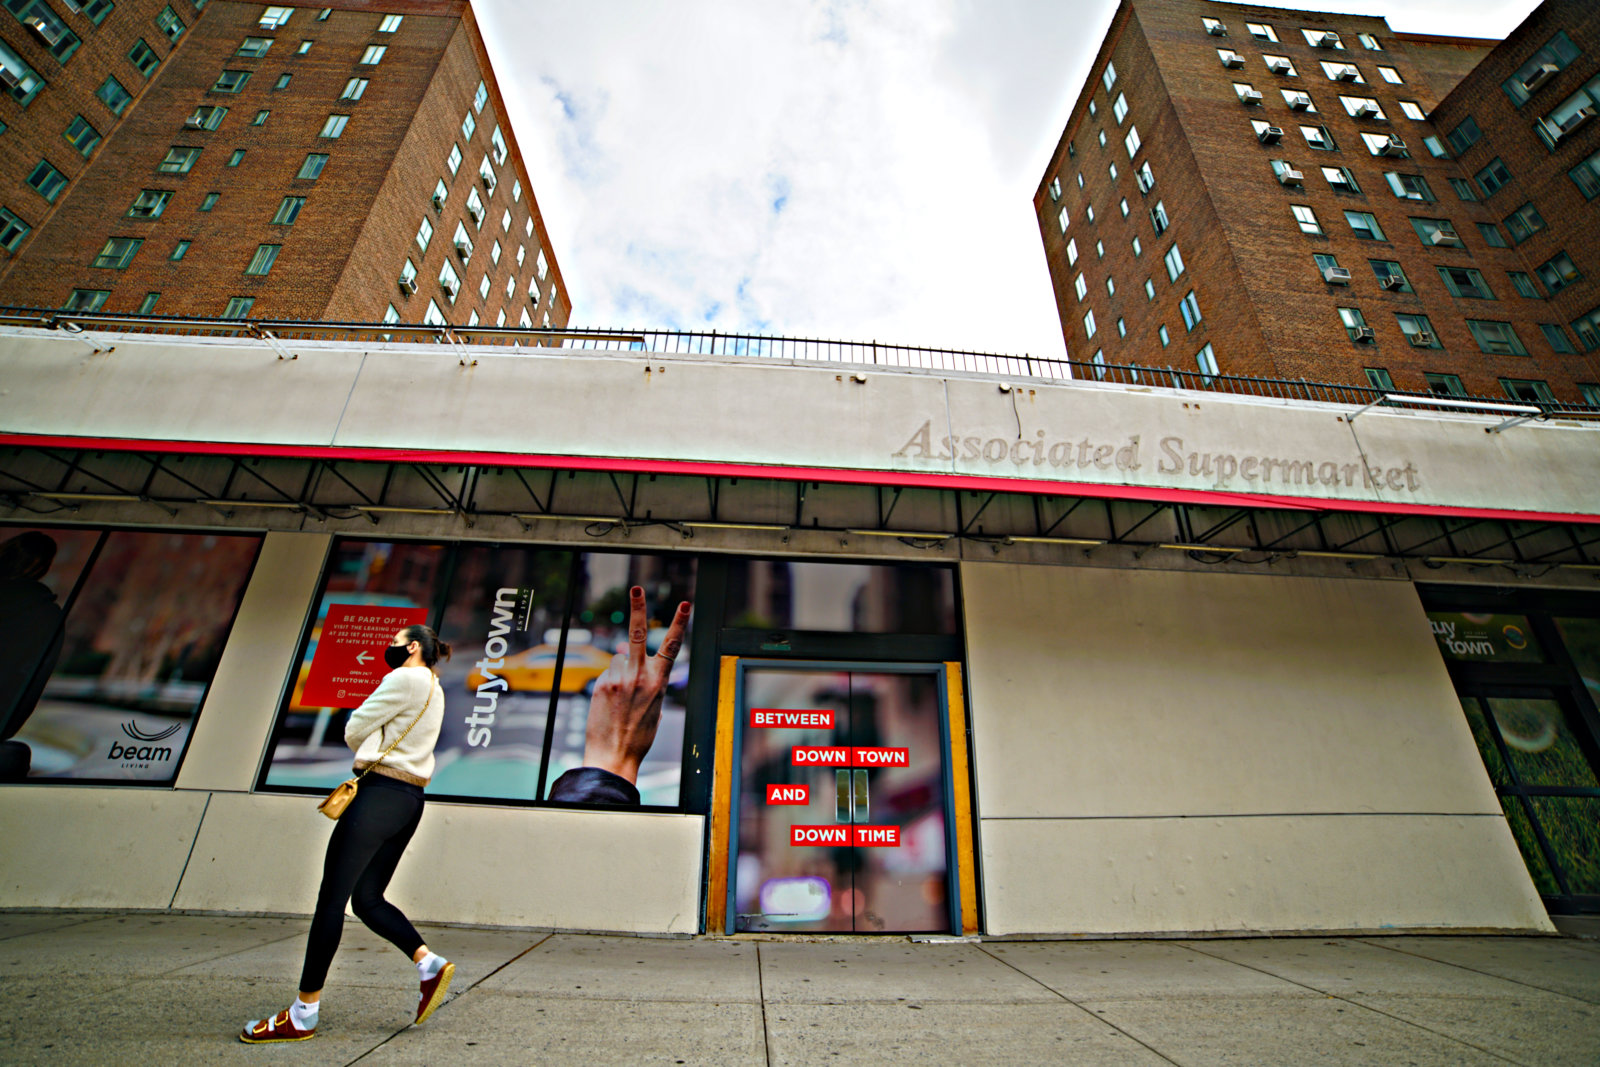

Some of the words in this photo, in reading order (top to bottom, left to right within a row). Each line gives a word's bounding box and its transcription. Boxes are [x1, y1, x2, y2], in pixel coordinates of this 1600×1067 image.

[891, 419, 1142, 471] Associated
[1158, 436, 1421, 492] Supermarket
[343, 615, 356, 623] BE
[357, 616, 381, 624] PART
[383, 617, 397, 625] OF
[1427, 618, 1456, 639] tuy
[1446, 638, 1495, 655] town
[464, 587, 519, 748] stuytown
[755, 713, 830, 725] BETWEEN
[108, 741, 172, 761] beam
[795, 750, 846, 763] DOWN
[857, 751, 906, 763] TOWN
[771, 788, 806, 801] AND
[794, 829, 846, 842] DOWN
[858, 829, 896, 842] TIME
